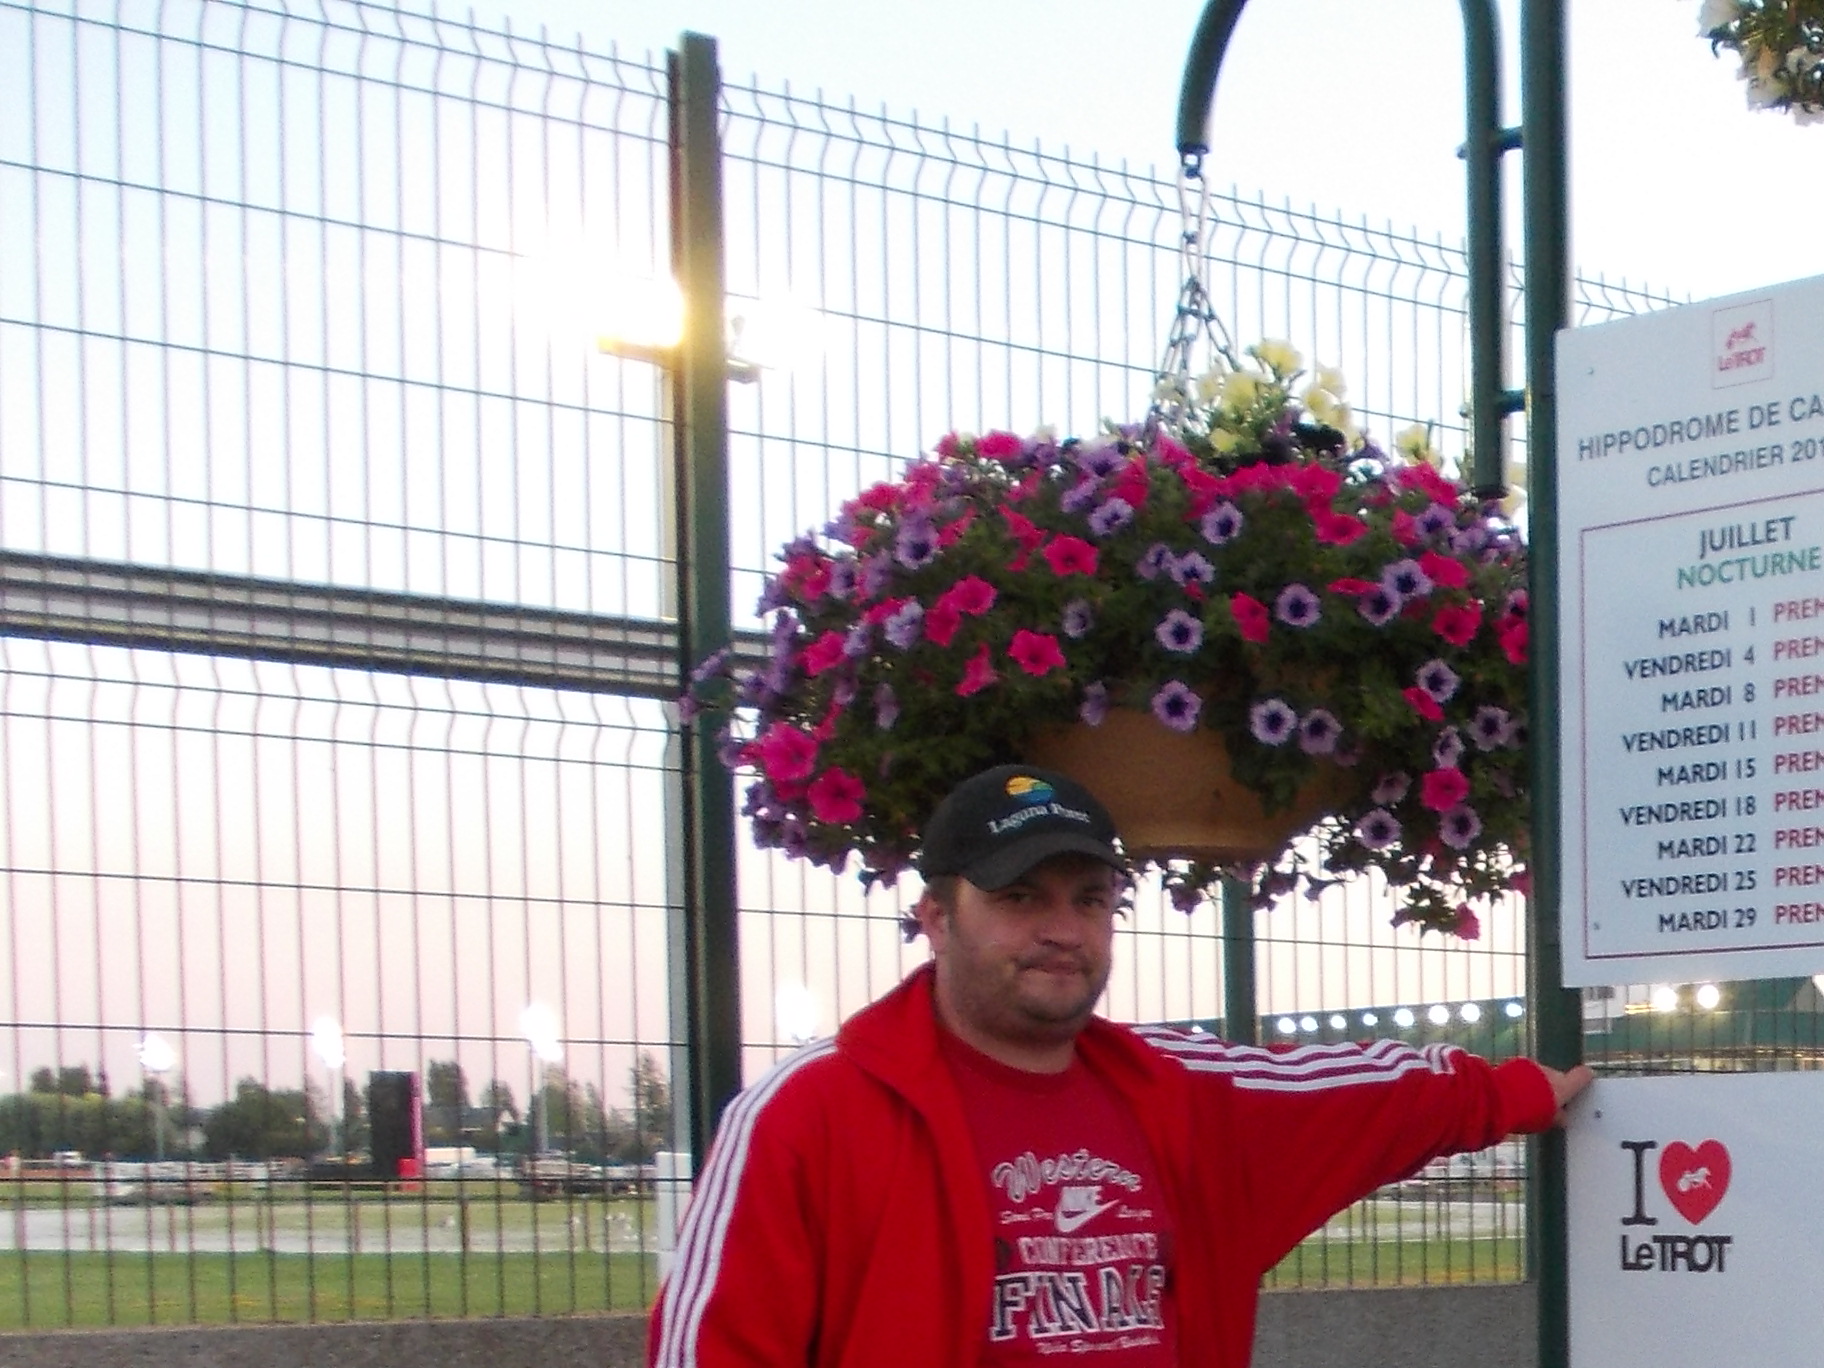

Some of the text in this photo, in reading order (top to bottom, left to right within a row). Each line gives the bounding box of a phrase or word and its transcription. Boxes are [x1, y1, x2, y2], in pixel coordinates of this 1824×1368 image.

[1578, 409, 1740, 461] HIPPODROME
[1749, 402, 1780, 430] DE
[1647, 444, 1784, 488] CALENDRIER
[1699, 516, 1796, 558] JUILLET
[1676, 547, 1823, 589] NOCTURNE
[1658, 611, 1729, 638] MARDI
[1749, 607, 1755, 626] 1
[1623, 648, 1732, 680] VENDREDI
[1744, 647, 1755, 665] 4
[1662, 686, 1732, 712] MARDI
[1744, 683, 1756, 702] 8
[1622, 723, 1730, 753] VENDREDI
[1738, 720, 1757, 740] 11
[1657, 760, 1727, 787] MARDI
[1736, 759, 1756, 778] 15
[1619, 798, 1726, 826] VENDREDI
[1736, 796, 1756, 816] 18
[1658, 834, 1728, 860] MARDI
[1734, 834, 1756, 853] 22
[1621, 872, 1728, 899] VENDREDI
[1734, 871, 1756, 891] 25
[1658, 909, 1728, 933] MARDI
[1734, 908, 1756, 928] 29
[1621, 1141, 1658, 1225] I
[1622, 1235, 1731, 1271] LeTROT
